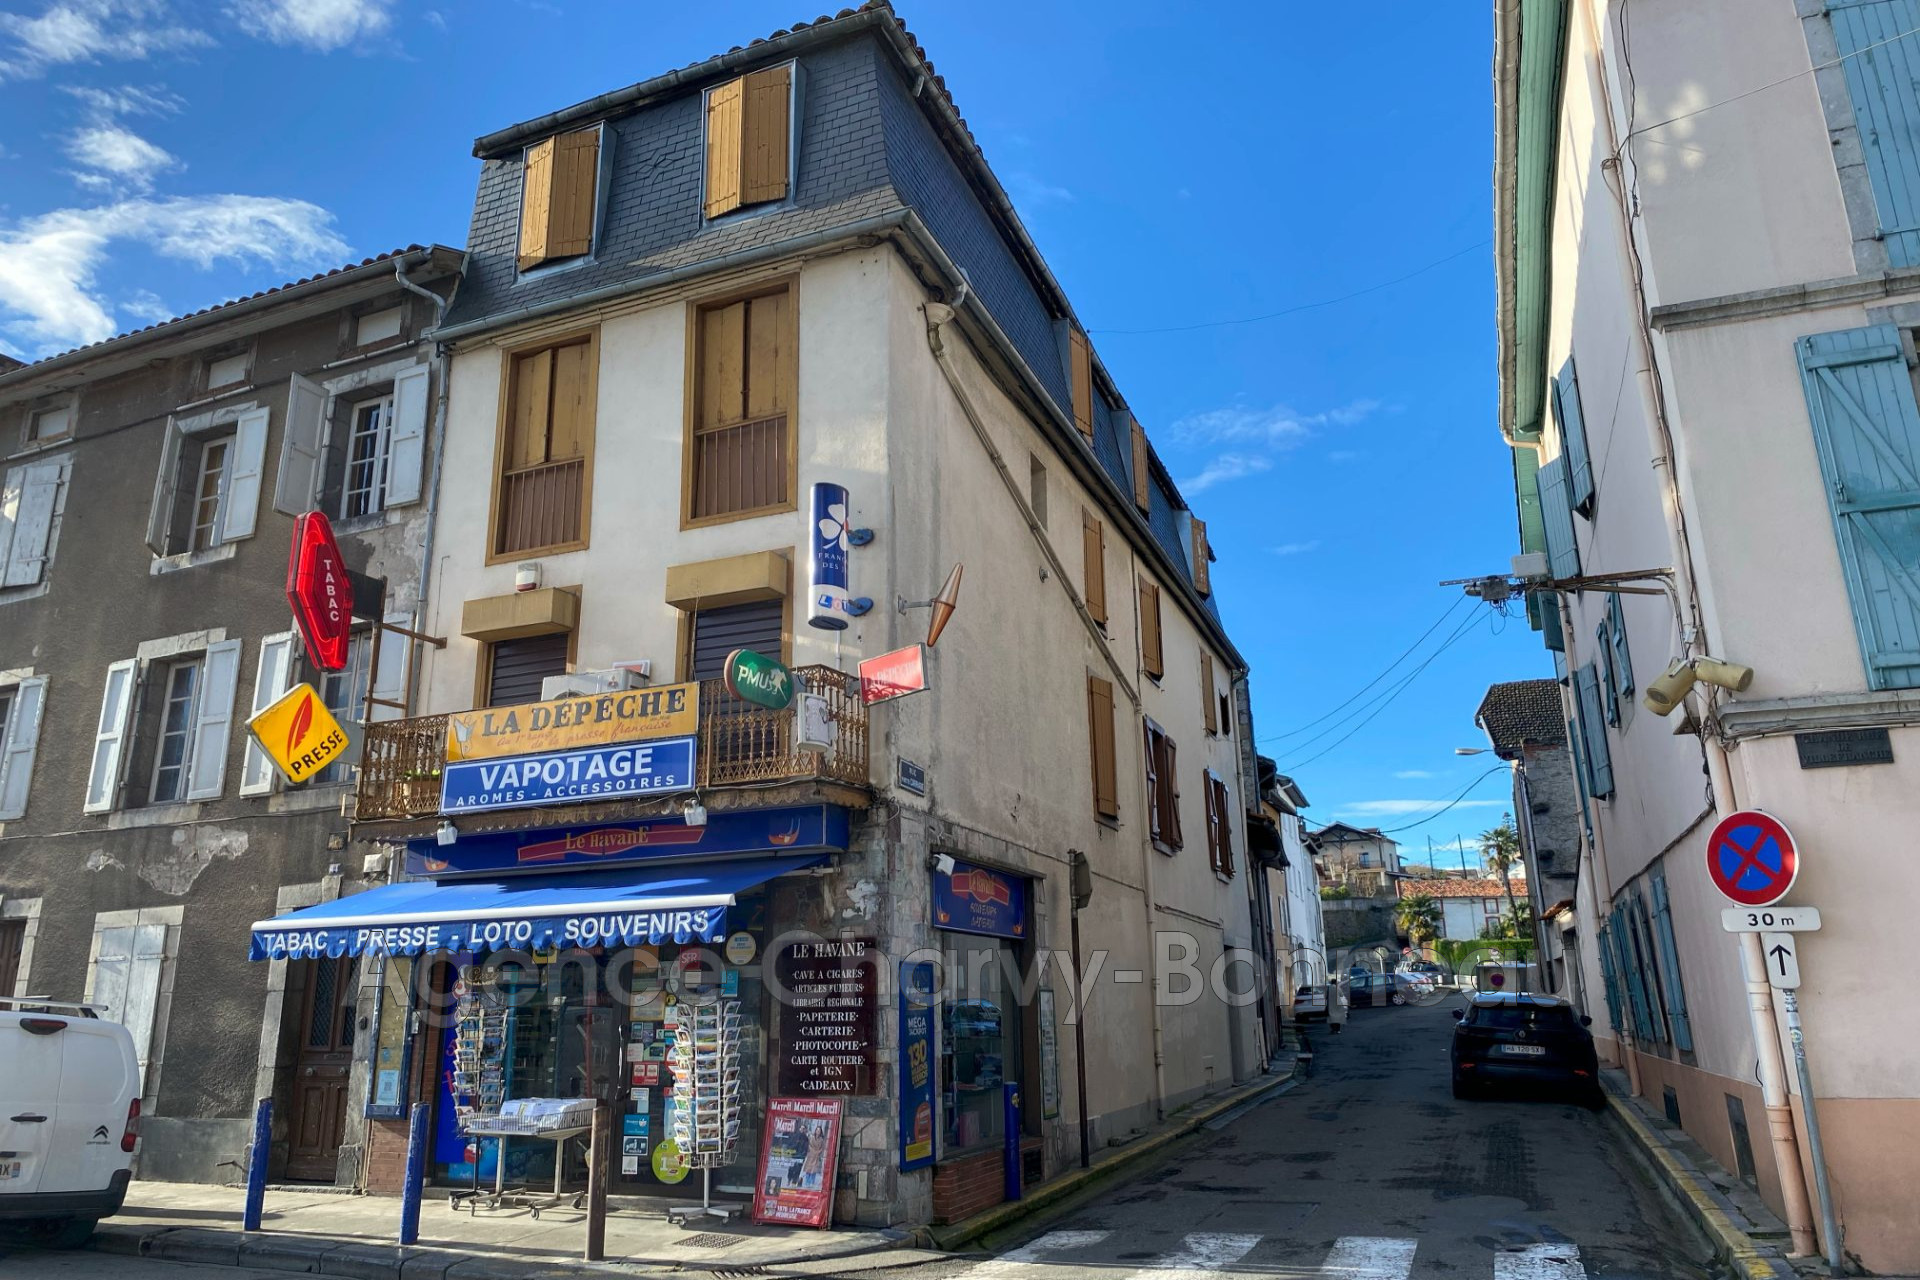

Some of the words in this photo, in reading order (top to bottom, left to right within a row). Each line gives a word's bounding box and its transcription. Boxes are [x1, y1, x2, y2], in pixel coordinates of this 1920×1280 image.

[323, 559, 340, 622] TABAC
[737, 664, 769, 690] PMU
[481, 710, 521, 737] LA
[529, 687, 686, 731] DÉPÊCHE
[291, 729, 343, 775] PRESSE
[480, 747, 653, 791] VAPOTAGE
[455, 790, 525, 807] AROMES
[543, 774, 676, 799] ACCESSOIRES
[565, 832, 586, 850] Le
[263, 930, 329, 951] TABAC
[356, 925, 441, 948] PRESSE
[470, 920, 533, 944] LOTO
[564, 910, 709, 940] SOUVENIRS
[1747, 912, 1775, 927] 30
[1780, 916, 1795, 926] m
[681, 952, 698, 963] SFR
[792, 944, 809, 959] LE
[814, 941, 865, 958] HAVANE
[791, 1055, 818, 1065] CARTE
[907, 1038, 928, 1067] 130
[809, 1066, 820, 1076] et
[824, 1066, 842, 1076] IGN
